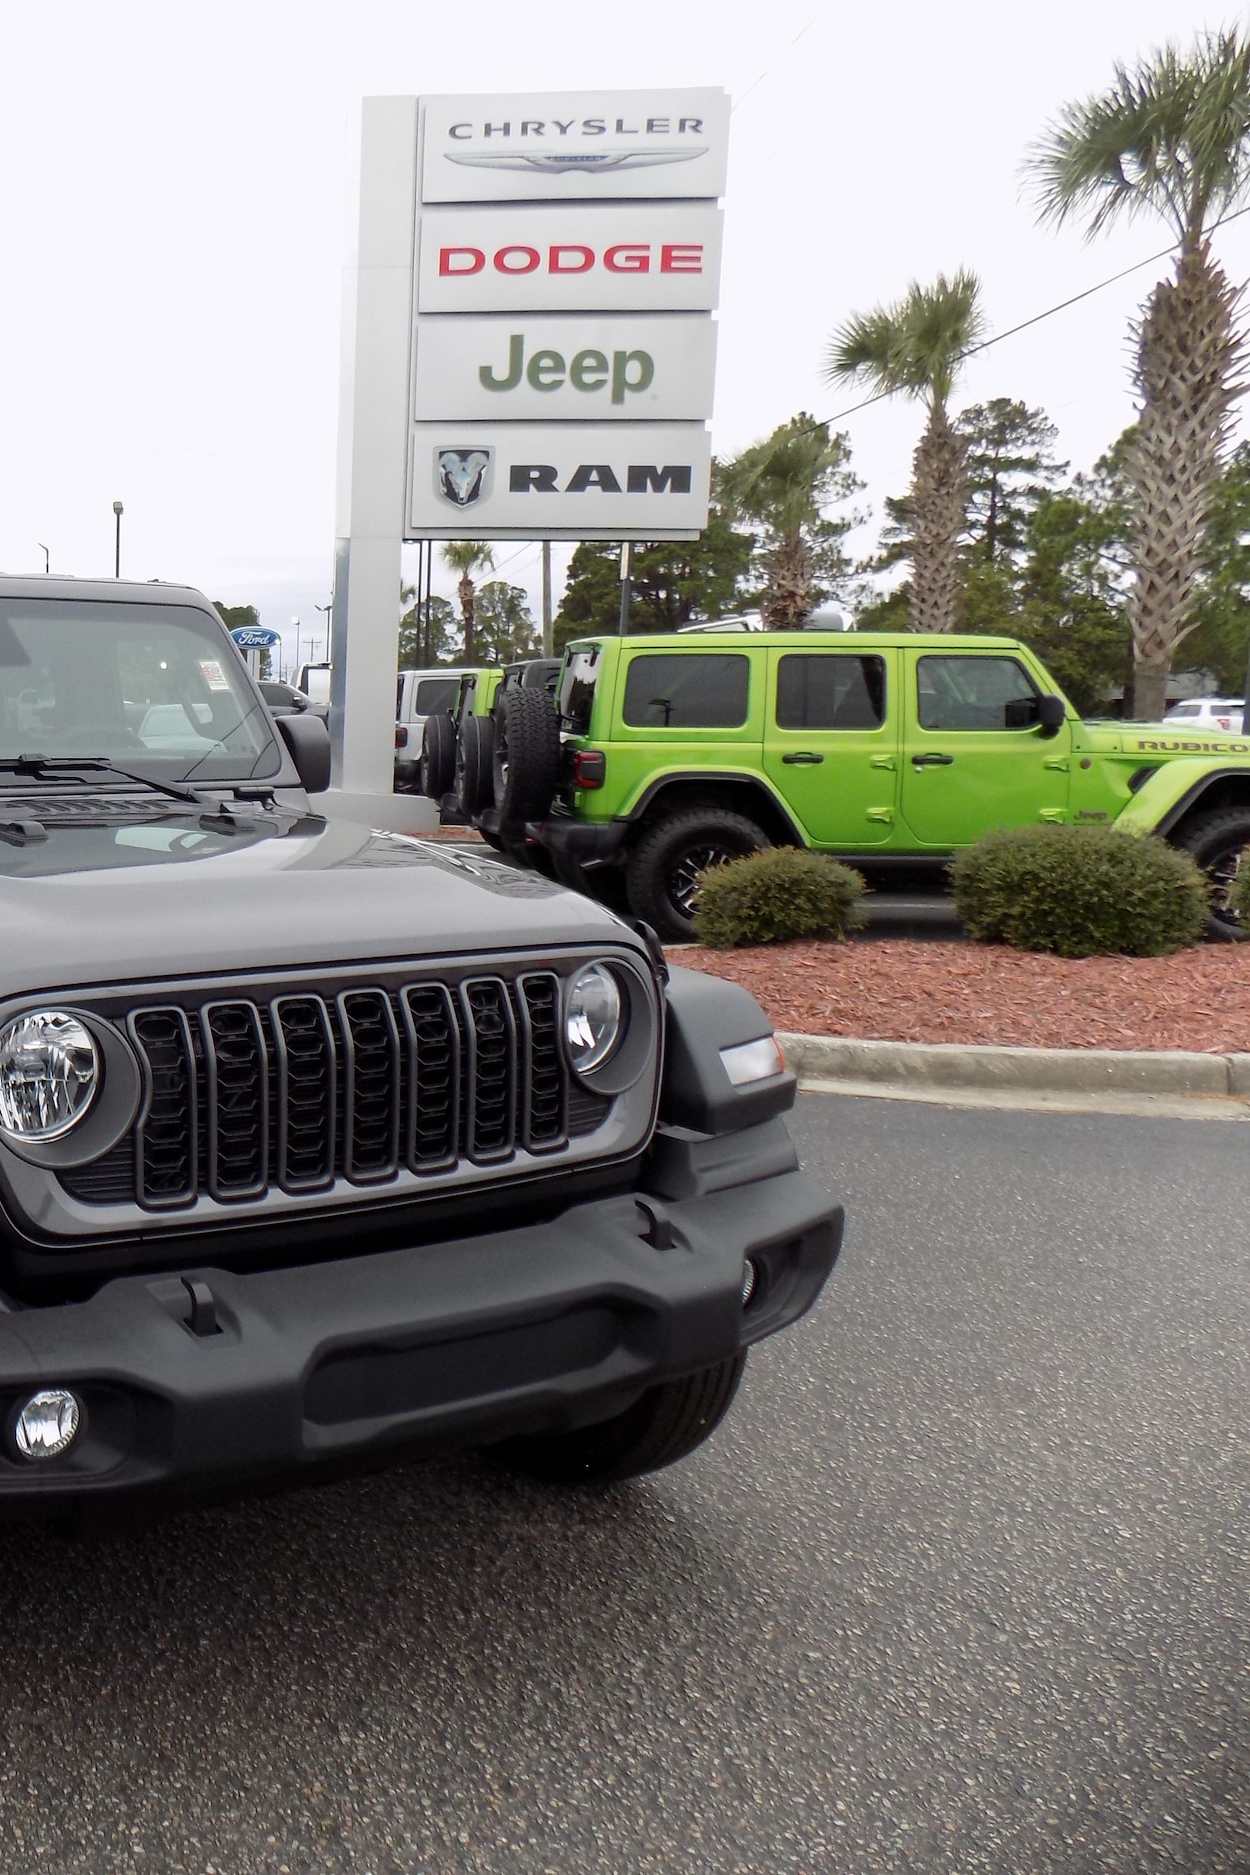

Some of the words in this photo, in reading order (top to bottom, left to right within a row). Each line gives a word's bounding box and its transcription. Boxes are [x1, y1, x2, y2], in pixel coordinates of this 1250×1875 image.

[448, 118, 704, 140] CHRYSLER
[438, 243, 704, 277] DODGE
[479, 334, 655, 404] Jeep
[508, 464, 692, 493] RAM
[238, 631, 270, 645] Ford
[1138, 740, 1250, 752] RUBICO
